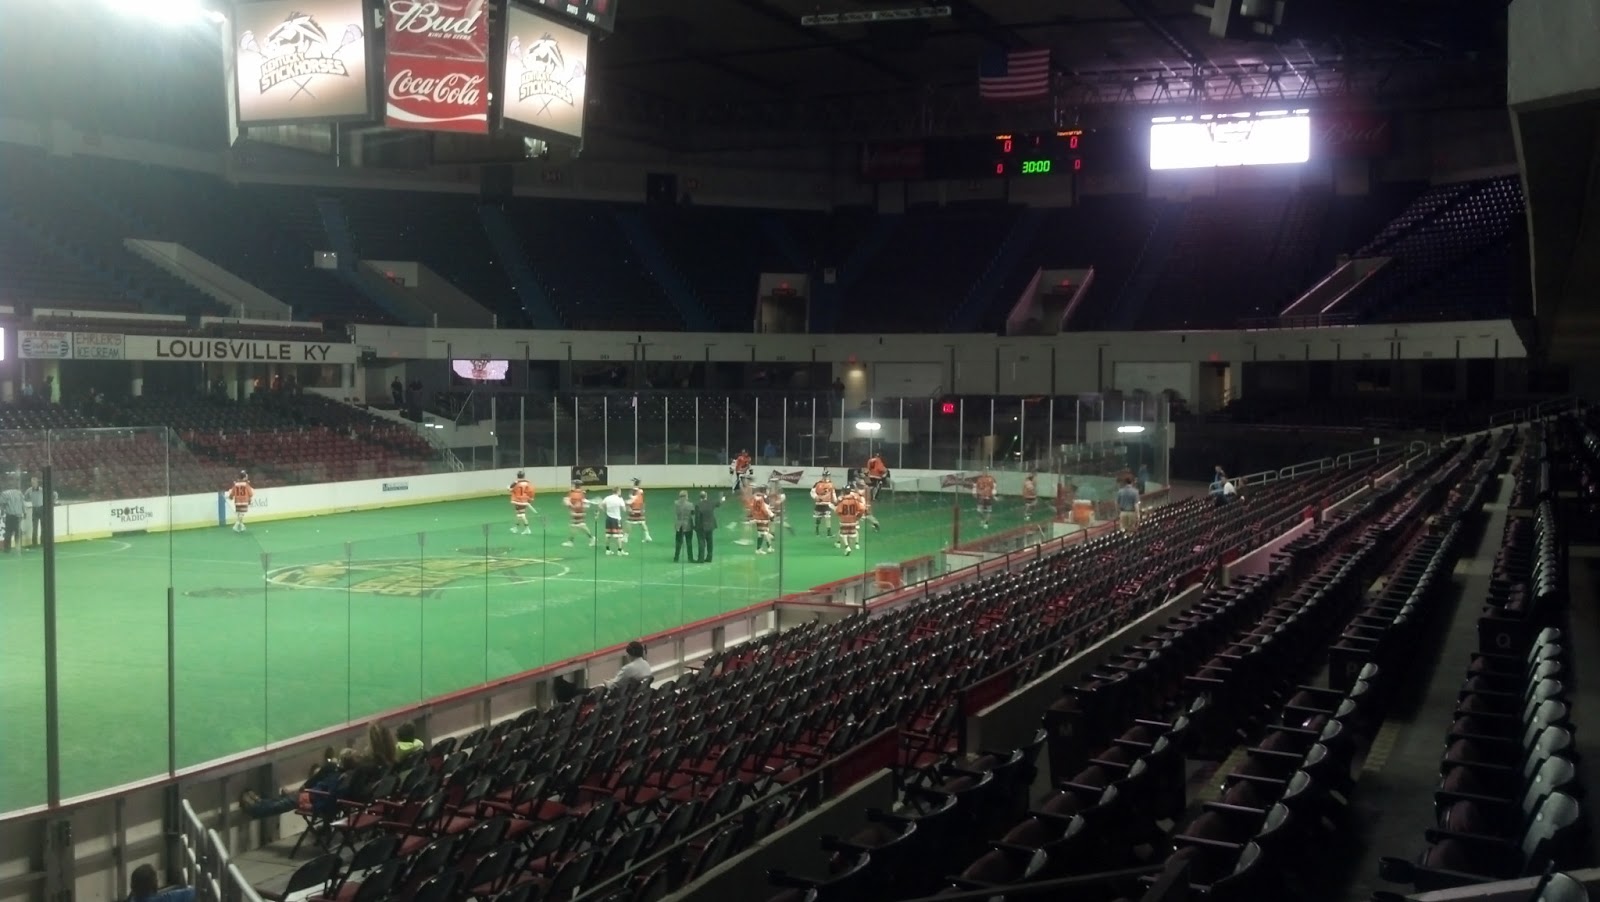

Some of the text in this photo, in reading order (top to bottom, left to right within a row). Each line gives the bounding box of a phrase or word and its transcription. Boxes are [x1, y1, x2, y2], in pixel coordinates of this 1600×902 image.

[390, 1, 482, 33] Bud
[261, 52, 304, 76] KENTUCKY
[260, 58, 348, 94] STICKHORSES
[389, 69, 485, 105] Coca-Cola
[1004, 140, 1012, 152] 0
[1070, 136, 1078, 149] 0
[996, 163, 1003, 174] 0
[1022, 160, 1050, 174] 30:00
[77, 346, 119, 359] ICE CREAM
[156, 339, 331, 361] LOUISVILLE KY
[120, 513, 145, 522] RADIO
